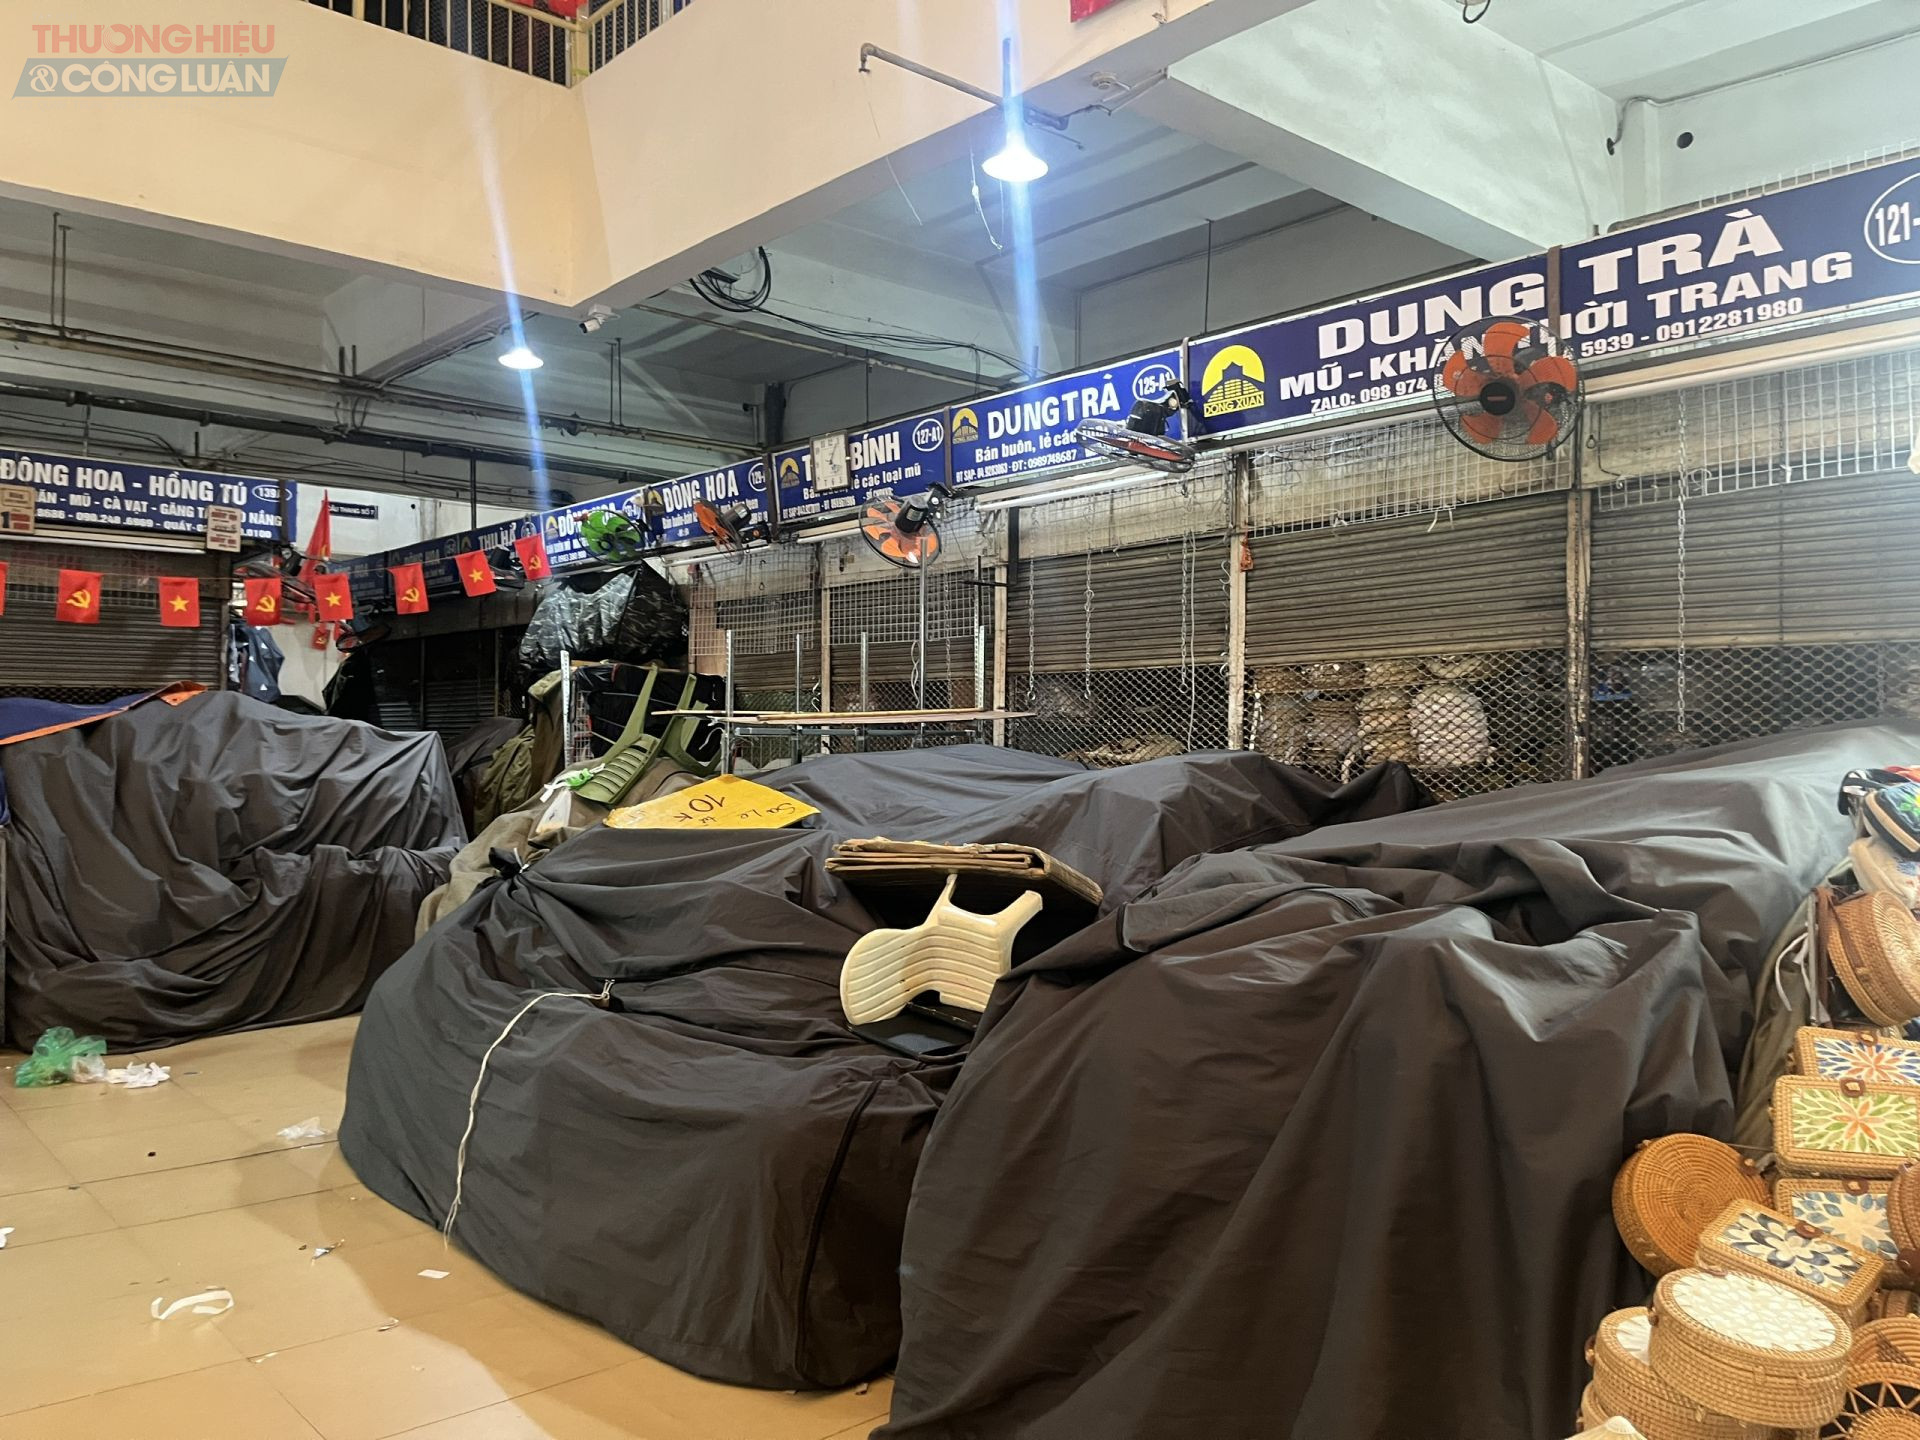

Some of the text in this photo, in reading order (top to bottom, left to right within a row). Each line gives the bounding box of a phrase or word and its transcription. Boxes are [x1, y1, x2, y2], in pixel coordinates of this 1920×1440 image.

[1319, 208, 1784, 359] DUNG TRÀ
[1647, 251, 1853, 318] TRANG
[1311, 394, 1356, 413] ZALO:
[1360, 385, 1391, 403] 098
[1396, 377, 1428, 397] 974
[1580, 332, 1634, 358] 5939
[1656, 297, 1804, 342] 0912281980
[987, 399, 1061, 440] DUNG
[850, 431, 901, 471] BÍNH
[915, 424, 943, 446] 127-A1
[975, 446, 999, 463] Bán
[1001, 438, 1036, 458] buôn,
[77, 467, 126, 493] HOA
[150, 471, 214, 502] HỒNG
[705, 470, 739, 502] HOA
[904, 463, 921, 479] mũ
[103, 496, 121, 510] CÀ
[124, 499, 148, 514] VẠT
